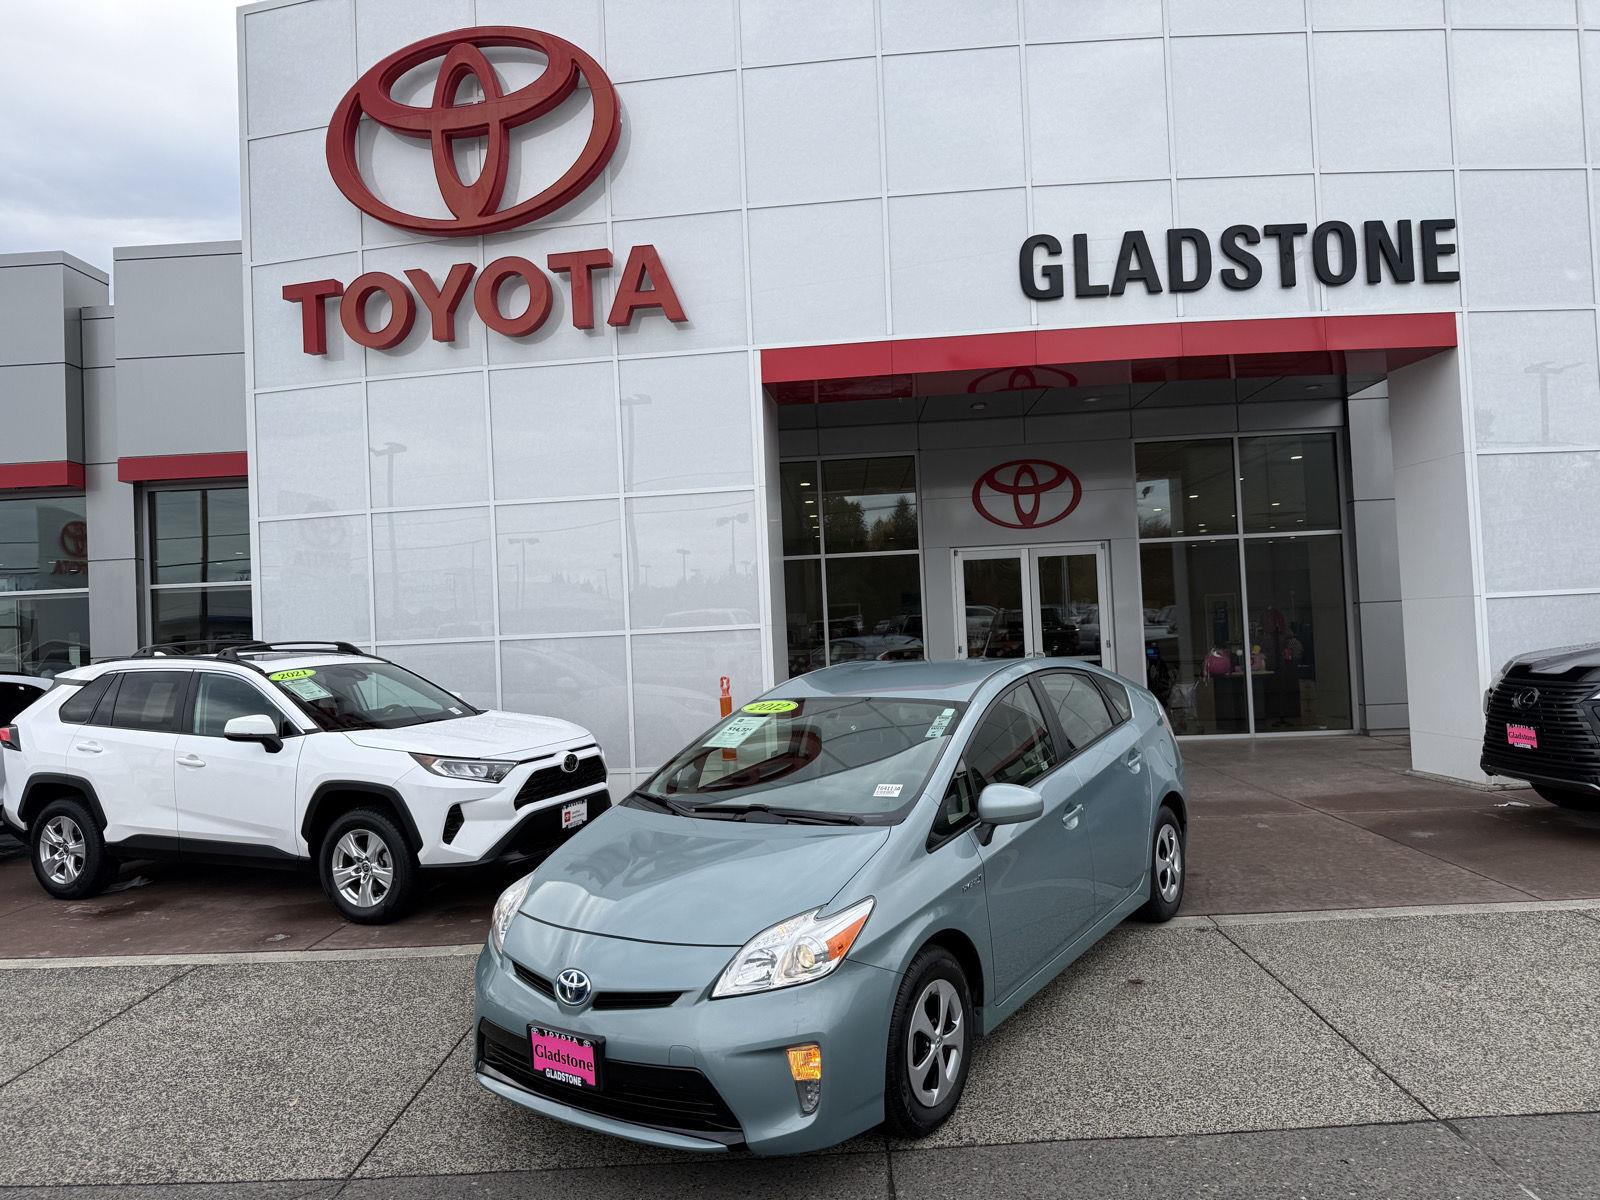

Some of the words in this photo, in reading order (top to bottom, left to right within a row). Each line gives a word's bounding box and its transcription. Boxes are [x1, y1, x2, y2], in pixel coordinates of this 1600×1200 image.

[1019, 219, 1460, 301] GLADSTONE
[282, 244, 689, 355] TOYOTA
[278, 670, 307, 679] 2021
[748, 702, 791, 710] 2012
[543, 1029, 578, 1043] TOYOTA
[534, 1044, 594, 1072] Gladstone
[545, 1068, 582, 1087] GLADSTONE
